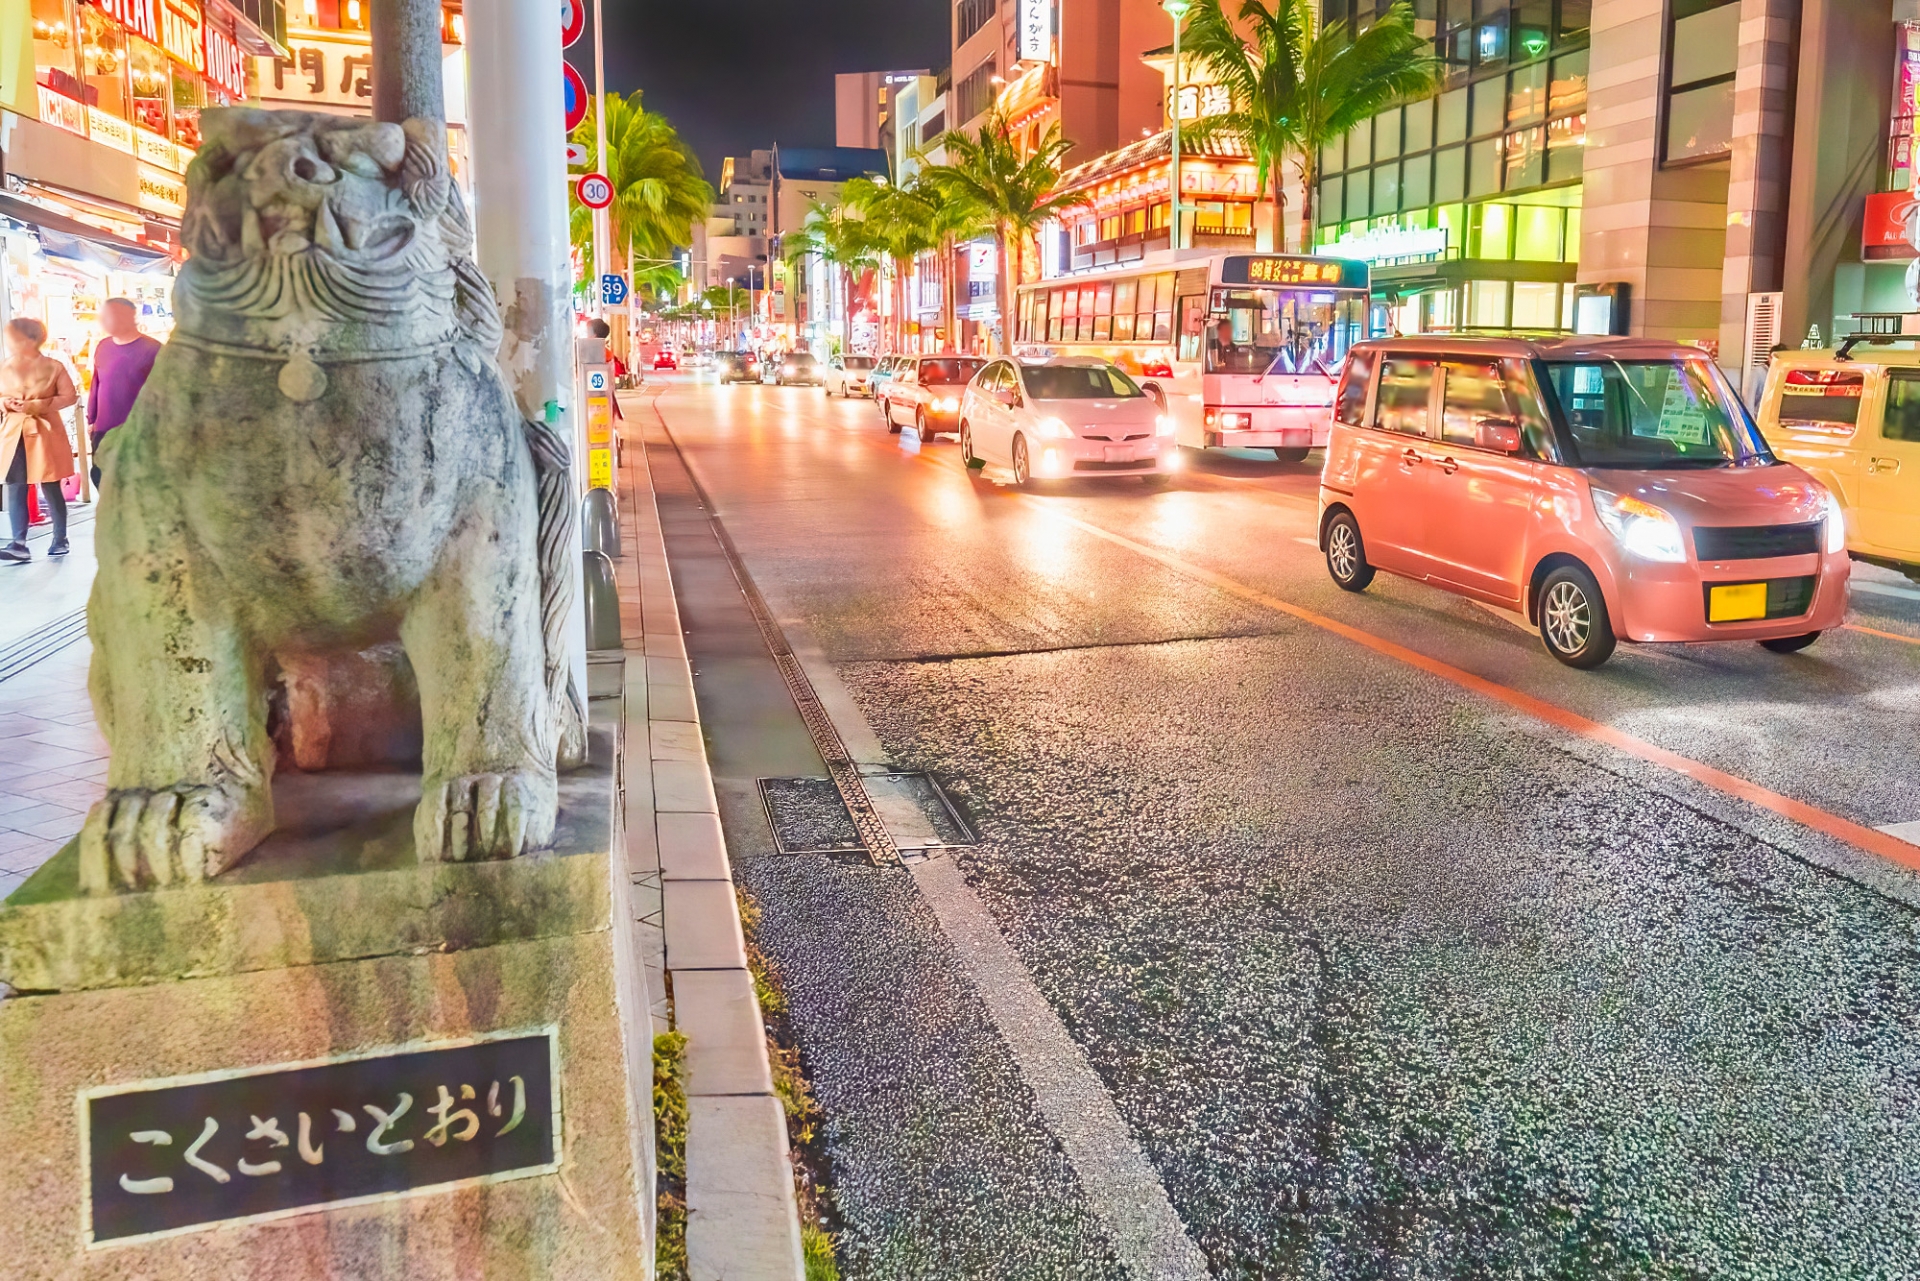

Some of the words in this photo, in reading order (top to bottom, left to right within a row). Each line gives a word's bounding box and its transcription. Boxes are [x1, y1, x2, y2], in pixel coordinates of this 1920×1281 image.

[206, 24, 248, 99] HOUSE
[586, 183, 606, 199] 30
[603, 282, 622, 296] 39
[592, 376, 603, 387] 39
[119, 1076, 526, 1194] こくさいとおり
